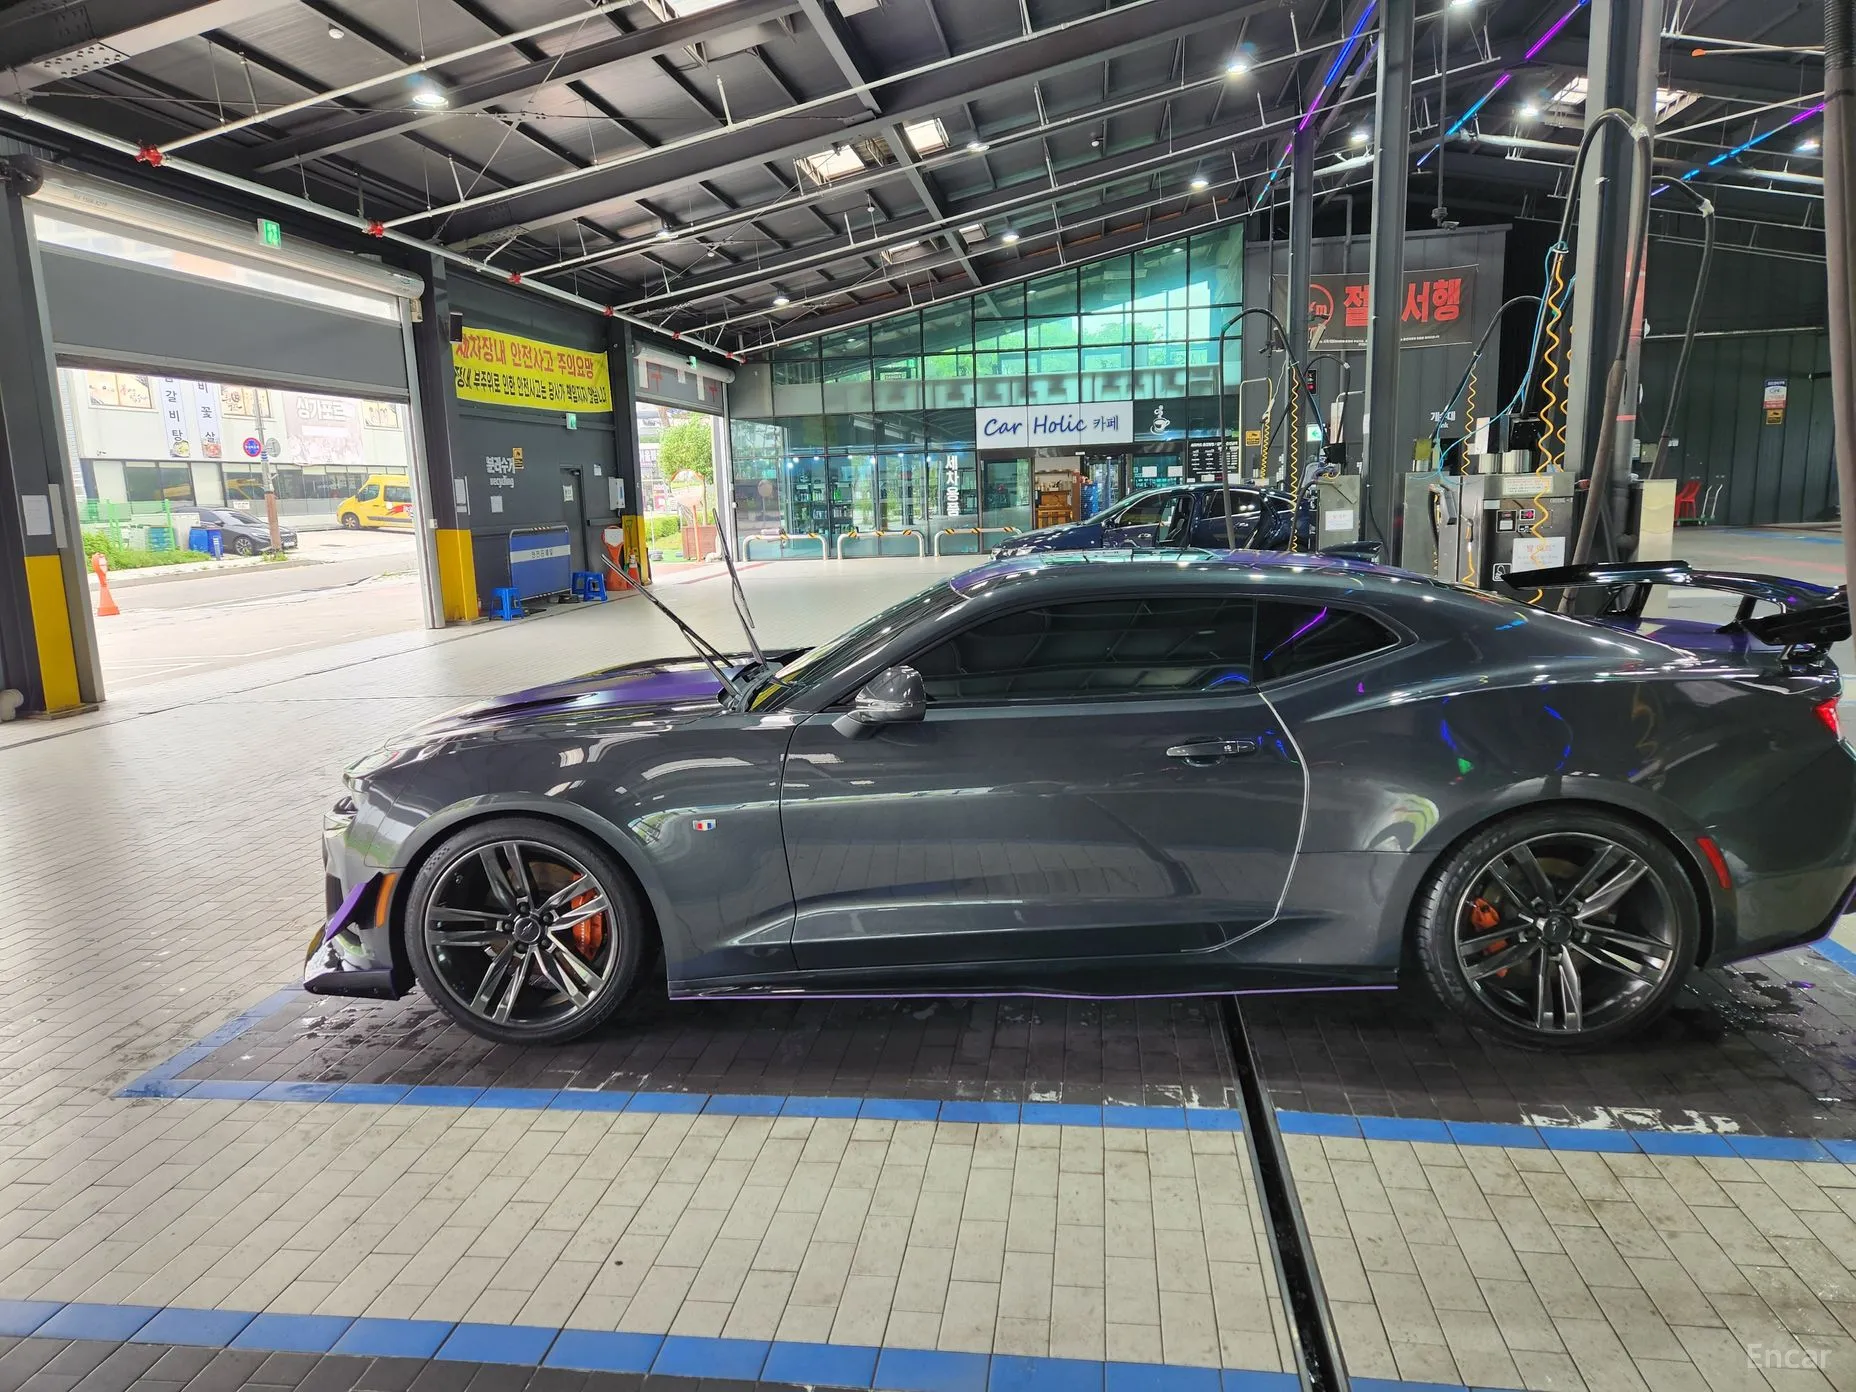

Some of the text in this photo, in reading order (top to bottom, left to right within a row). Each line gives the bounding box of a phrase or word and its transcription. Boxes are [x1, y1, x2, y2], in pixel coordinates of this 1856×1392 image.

[1401, 278, 1462, 323] 서행
[510, 342, 554, 373] 안전사고
[557, 352, 594, 379] 주의요망
[502, 374, 516, 396] 인한
[517, 376, 547, 399] 안전사고는
[984, 414, 1119, 437] Car Holic 카페
[1430, 411, 1456, 421] 개대
[945, 455, 960, 517] 세차용품
